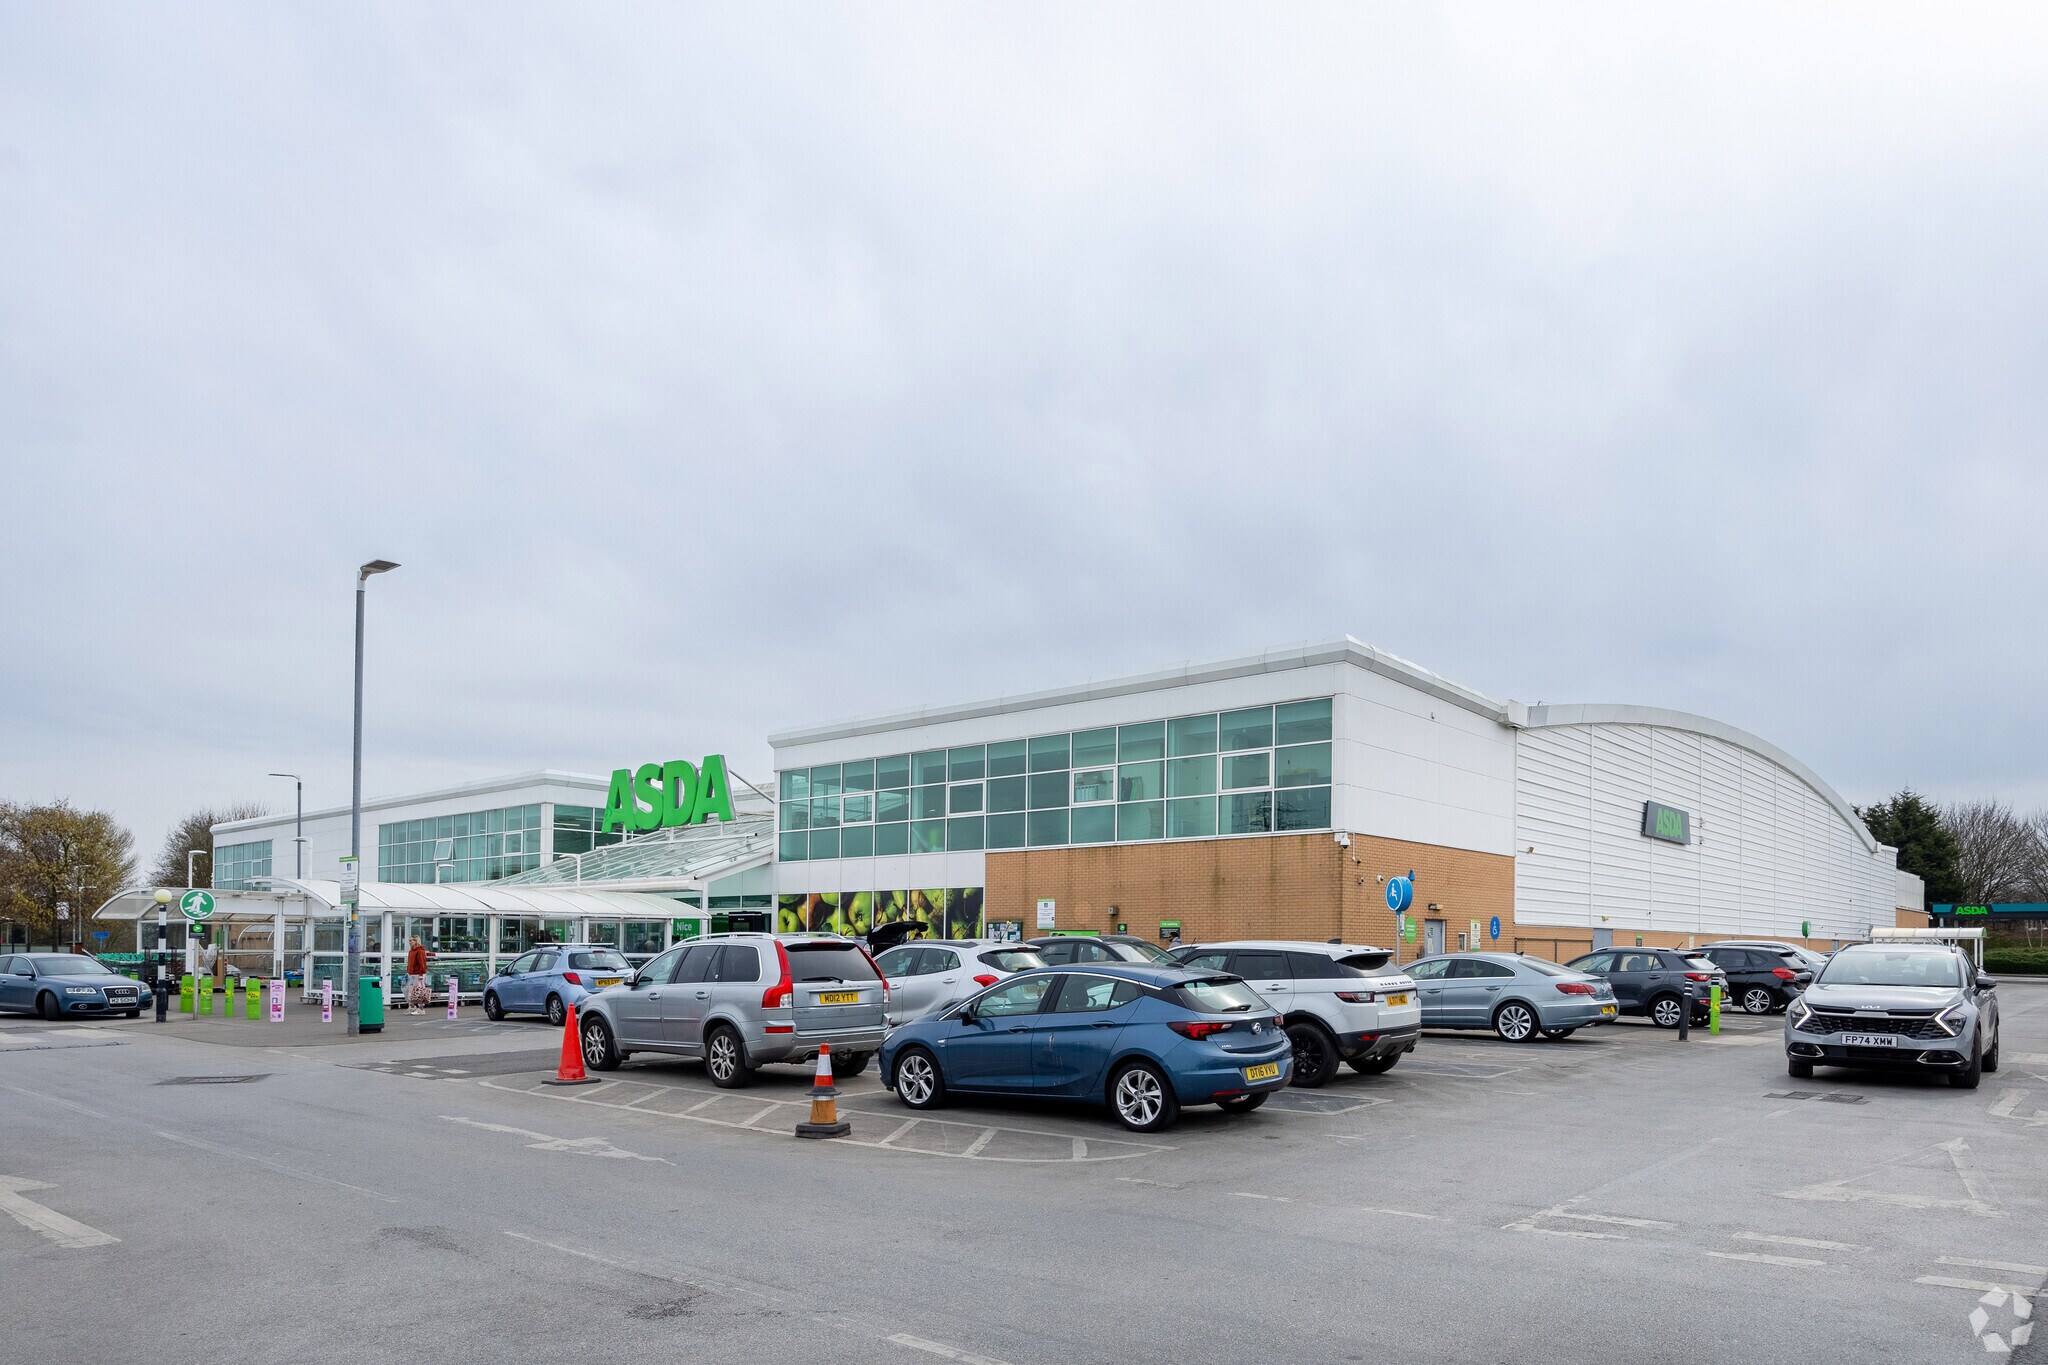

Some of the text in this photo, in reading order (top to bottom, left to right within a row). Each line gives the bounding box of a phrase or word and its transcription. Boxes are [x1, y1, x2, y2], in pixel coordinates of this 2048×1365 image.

[601, 754, 736, 833] ASDA
[1656, 807, 1682, 839] ASDA
[1955, 906, 1988, 915] ASDA
[676, 922, 693, 931] Nice
[1845, 1036, 1893, 1046] FP74 XMW
[1250, 1067, 1264, 1079] DT16
